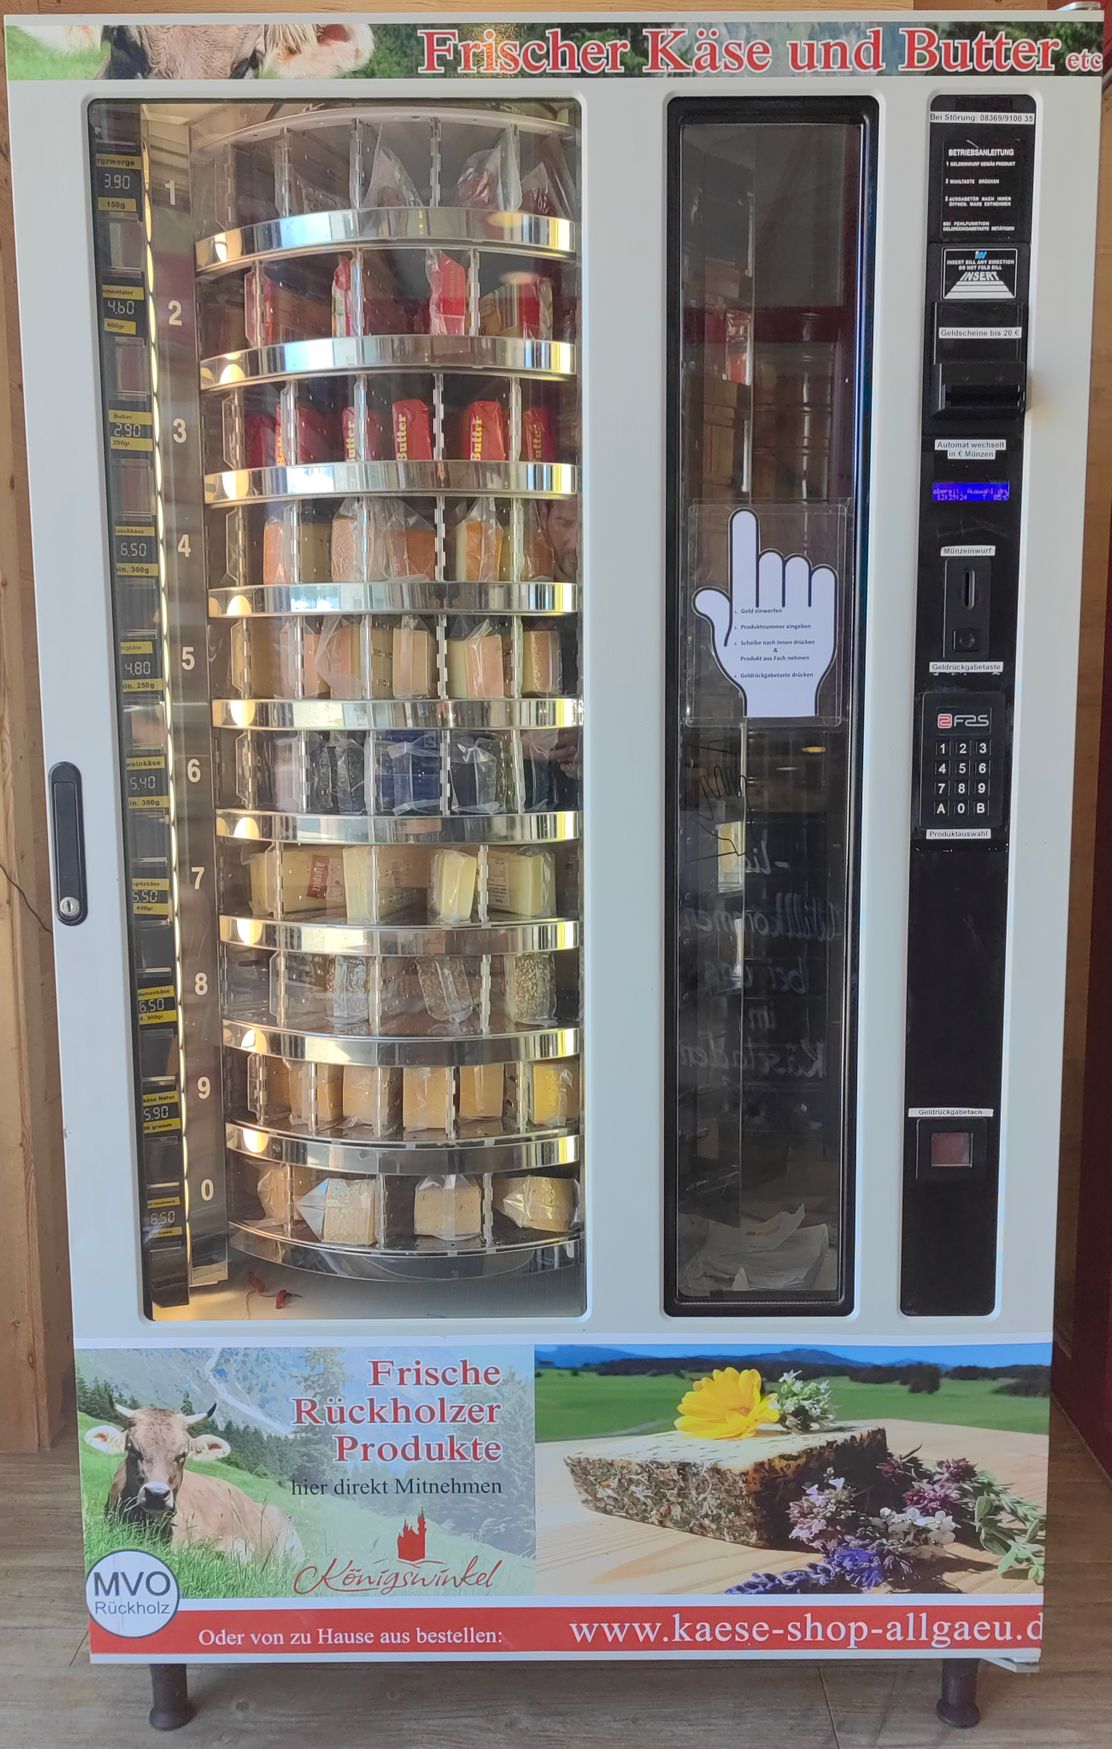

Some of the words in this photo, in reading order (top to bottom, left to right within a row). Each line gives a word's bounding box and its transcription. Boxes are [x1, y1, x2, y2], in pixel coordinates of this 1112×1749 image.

[417, 28, 630, 74] Frischer
[643, 28, 772, 74] Käse
[787, 27, 886, 72] und
[899, 26, 1062, 72] Butter
[1066, 48, 1103, 72] etc
[930, 113, 942, 121] Bei
[980, 114, 1022, 122] 08369/9100
[948, 148, 1014, 157] BETRIEBSANLEITUNG
[165, 180, 176, 205] 1
[107, 201, 126, 210] 150g
[960, 271, 999, 281] INSERT
[168, 300, 182, 326] 2
[941, 329, 988, 337] Geldscheine
[990, 329, 1002, 337] bis
[173, 418, 187, 443] 3
[396, 413, 408, 461] Butter
[964, 450, 994, 458] Münzen
[177, 534, 191, 558] 4
[943, 547, 992, 555] Münzeinwurf
[182, 646, 195, 670] 5
[931, 664, 1001, 672] Geldrückgabetaste
[940, 743, 945, 753] 1
[959, 743, 967, 753] 2
[979, 743, 987, 753] 3
[187, 758, 201, 783] 6
[938, 763, 946, 774] 4
[958, 763, 966, 774] 5
[978, 763, 986, 774] 6
[938, 783, 945, 794] 7
[958, 783, 965, 794] 8
[978, 783, 986, 794] 9
[936, 803, 946, 814] A
[957, 803, 965, 814] 0
[976, 803, 985, 814] B
[929, 830, 988, 838] Produktauswahl
[191, 866, 205, 890] 7
[194, 972, 208, 995] 8
[197, 1076, 211, 1099] 9
[201, 1178, 214, 1201] 0
[368, 1359, 502, 1387] Frische
[290, 1396, 503, 1425] Rückholzer
[333, 1434, 503, 1463] Produkte
[291, 1479, 327, 1495] hier
[334, 1479, 388, 1495] direkt
[395, 1478, 503, 1494] Mitnehmen
[293, 1555, 503, 1595] Königswinkel
[93, 1571, 171, 1597] MVO
[95, 1601, 170, 1615] Rückholz
[569, 1611, 1043, 1648] www.kaese-shop-allgaeu.d
[198, 1629, 244, 1646] Oder
[250, 1633, 284, 1645] von
[290, 1633, 311, 1645] zu
[317, 1628, 374, 1644] Hause
[380, 1633, 410, 1644] aus
[416, 1627, 503, 1644] bestellen:
